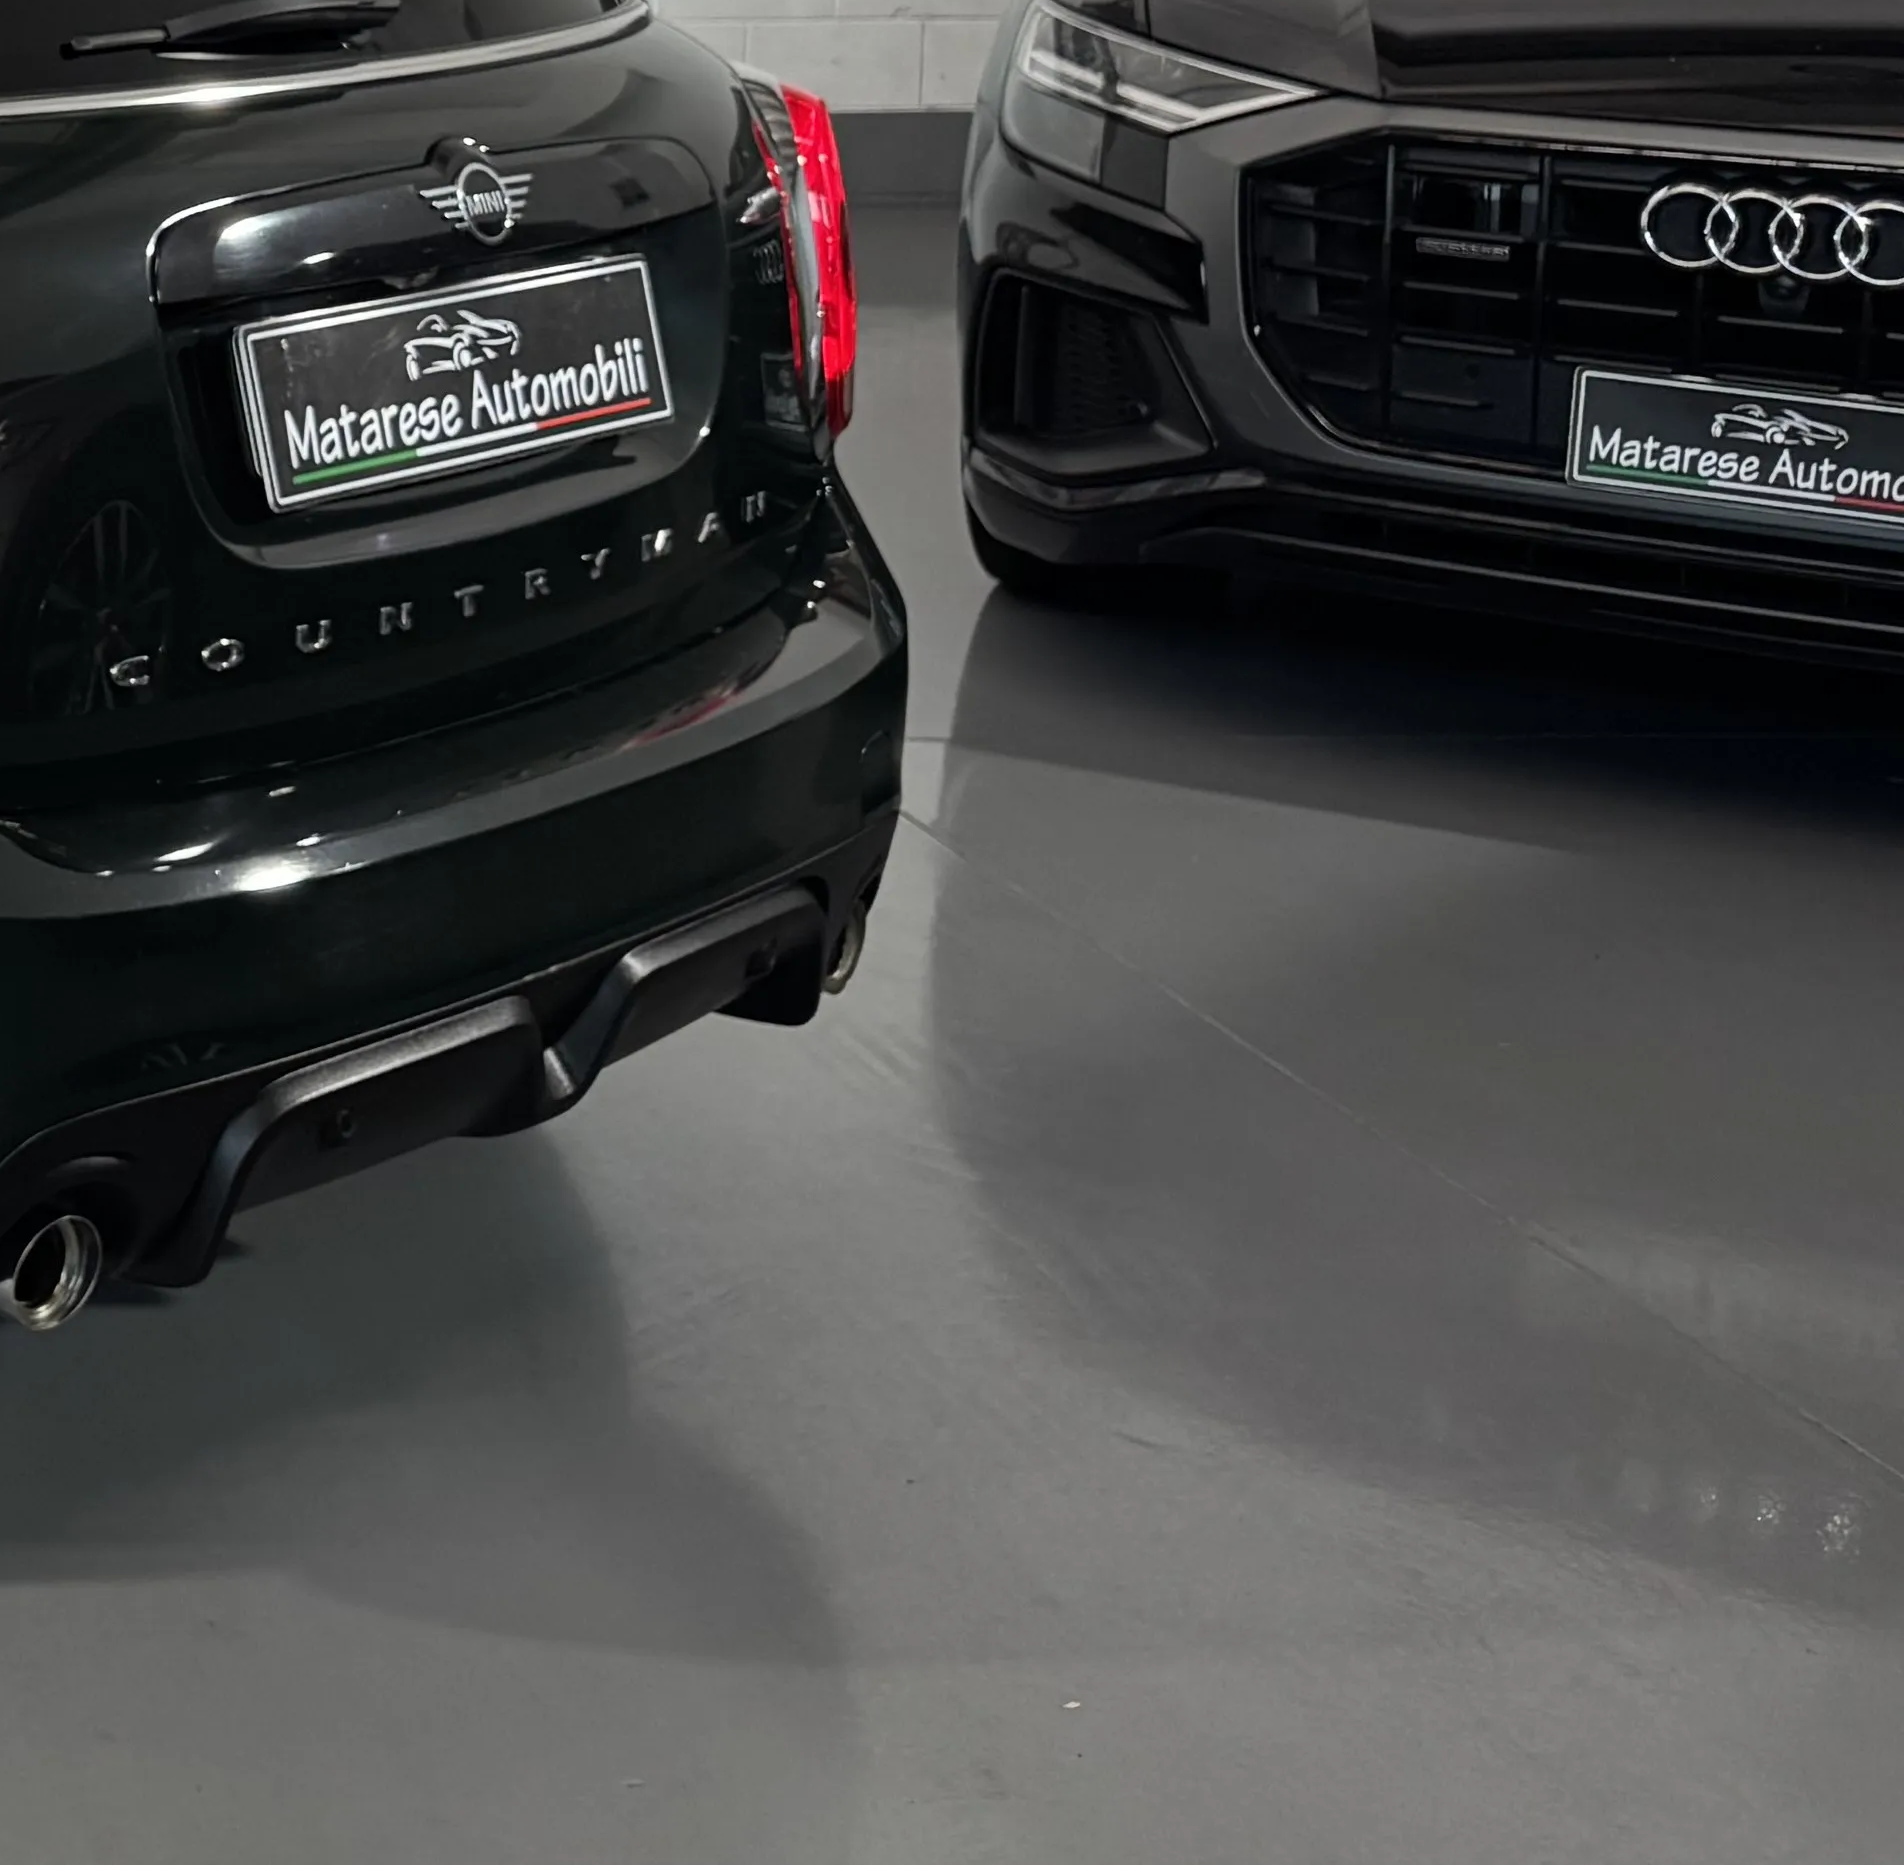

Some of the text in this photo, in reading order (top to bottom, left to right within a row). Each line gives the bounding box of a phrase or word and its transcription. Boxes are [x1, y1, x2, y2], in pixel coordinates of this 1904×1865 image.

[464, 189, 505, 217] MINI
[283, 336, 650, 471] Matarese Automobili
[1588, 424, 1760, 482] Matarese
[108, 490, 768, 688] COUNTRYMAN
